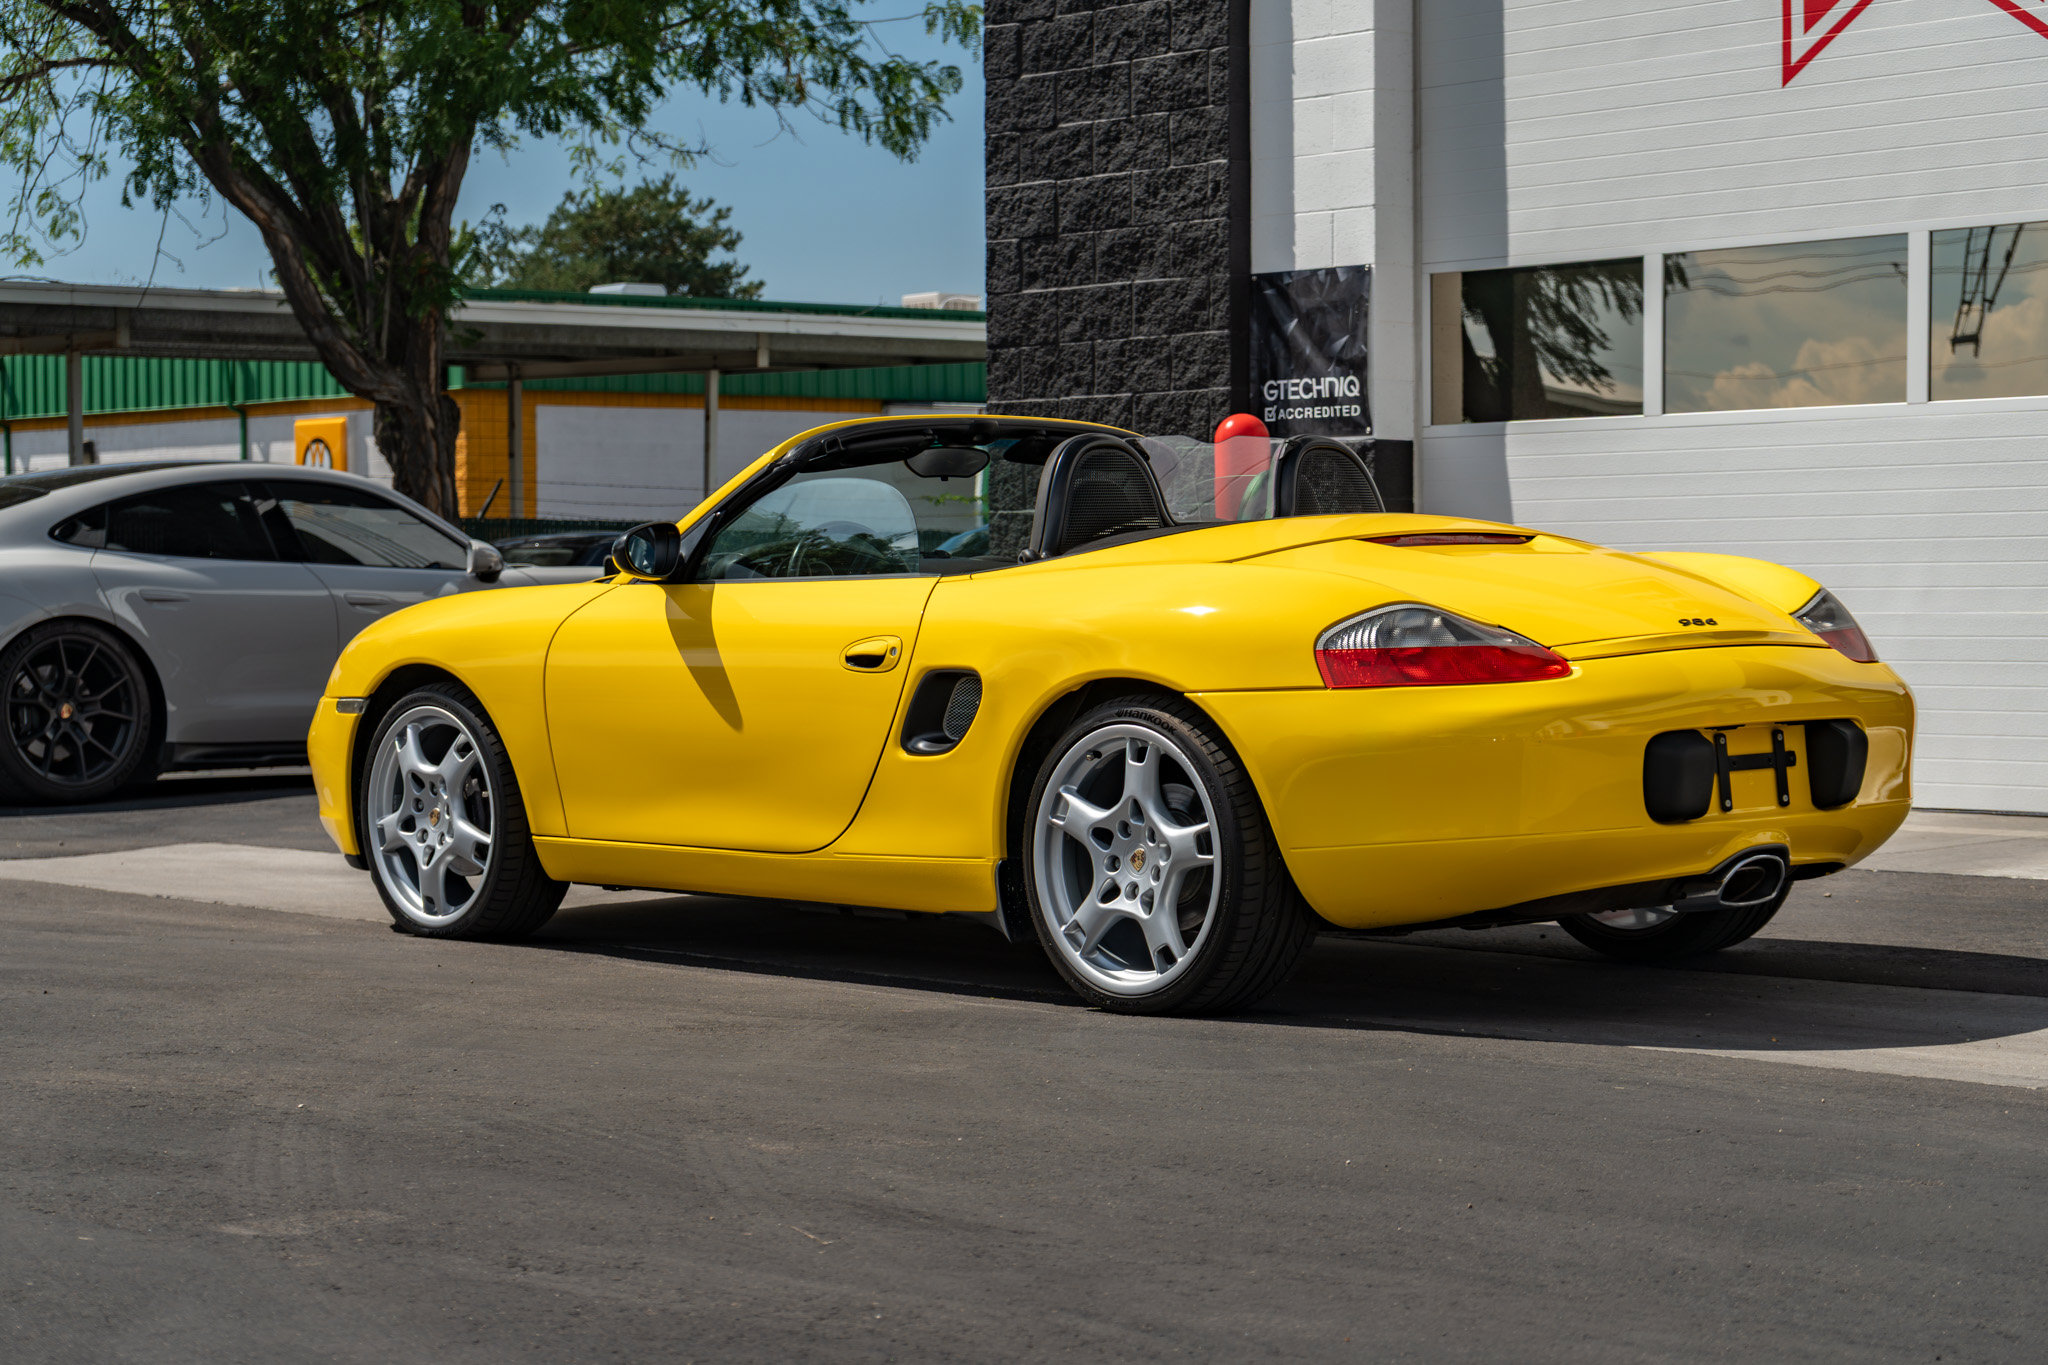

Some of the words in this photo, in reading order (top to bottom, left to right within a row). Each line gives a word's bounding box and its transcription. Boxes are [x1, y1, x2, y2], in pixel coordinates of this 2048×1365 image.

[1263, 375, 1360, 401] GTECHNIQ
[1278, 405, 1361, 420] ACCREDITED
[1678, 617, 1719, 627] 986
